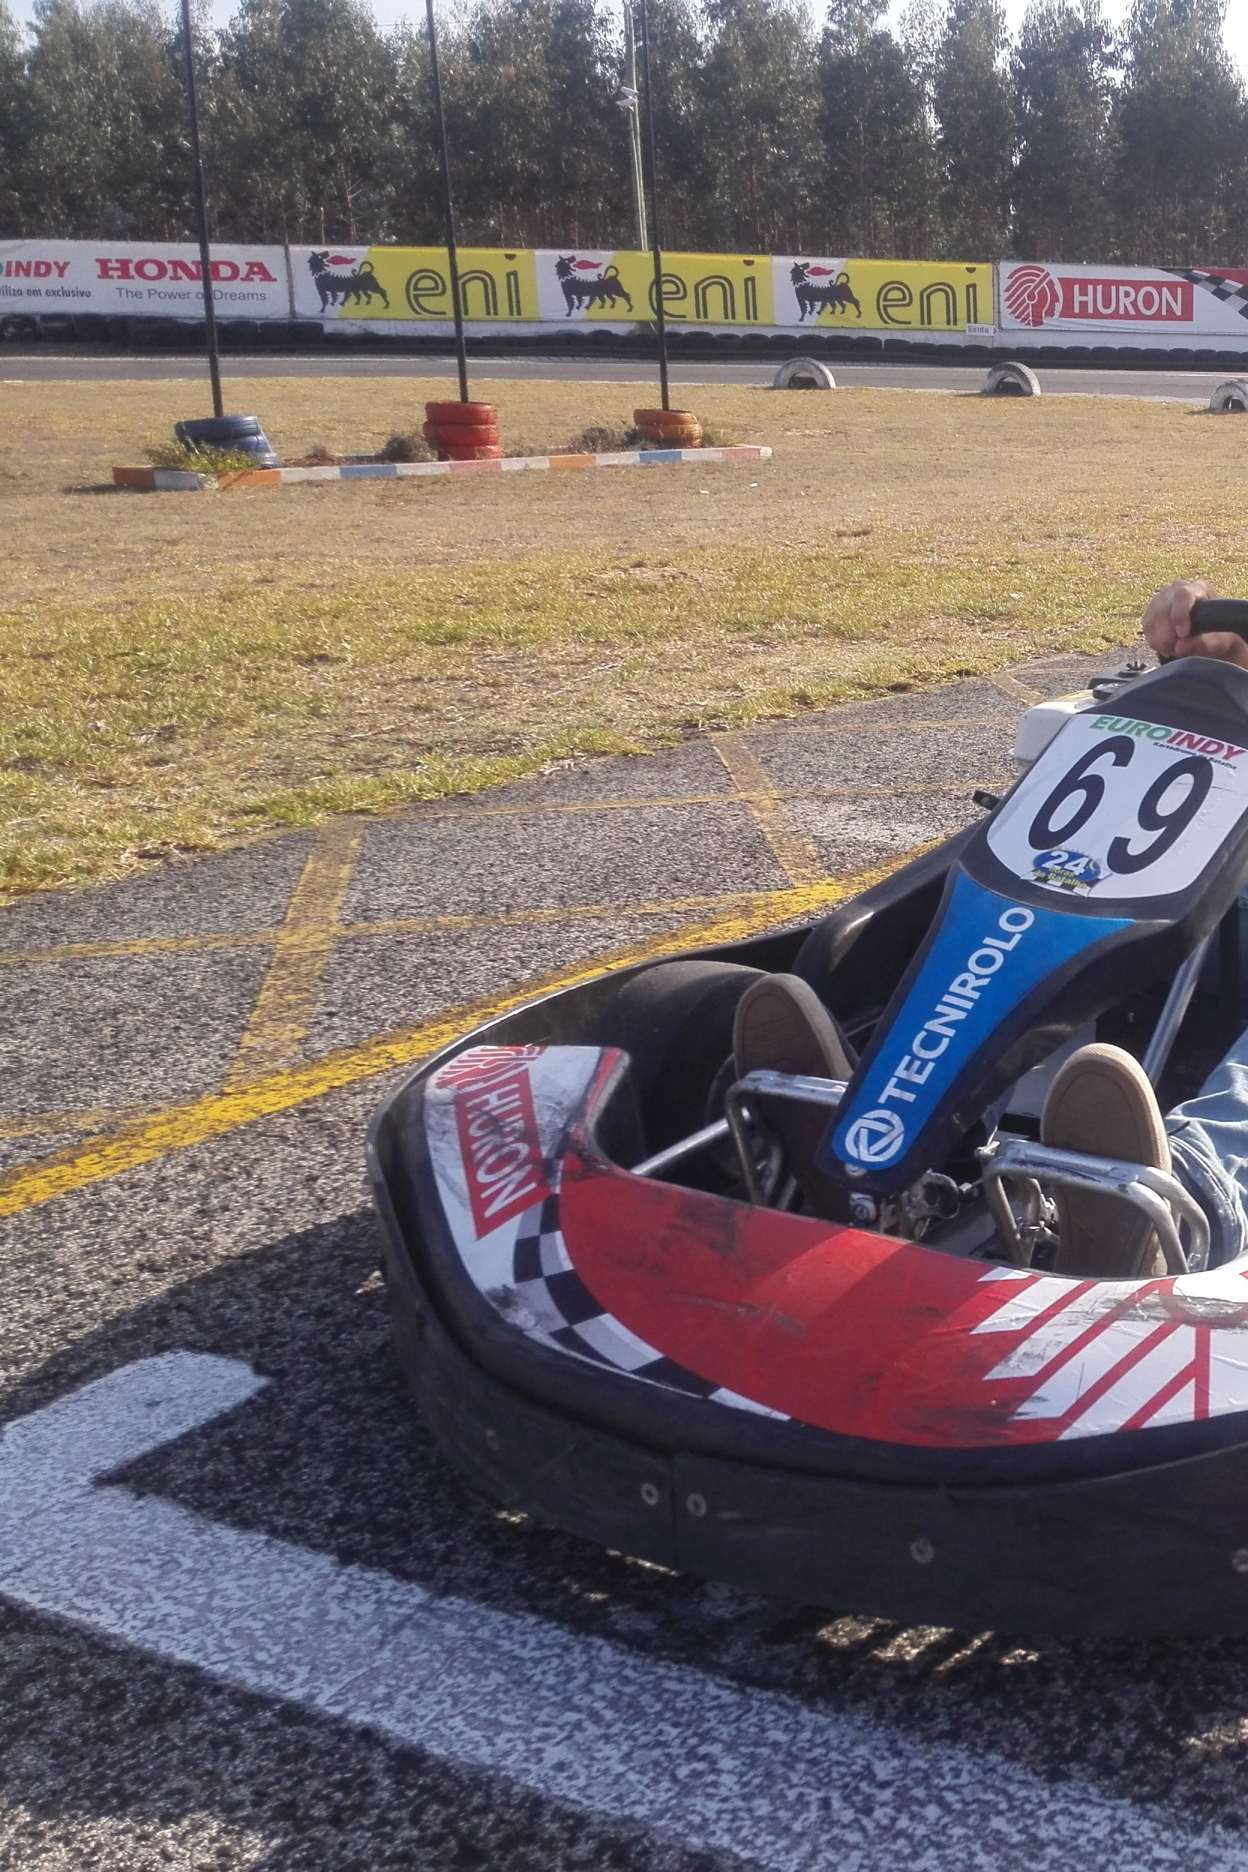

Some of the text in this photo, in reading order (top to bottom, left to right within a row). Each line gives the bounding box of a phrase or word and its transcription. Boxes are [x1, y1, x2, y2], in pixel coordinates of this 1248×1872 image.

[0, 260, 71, 278] INDY
[95, 257, 278, 283] HONDA
[116, 287, 144, 300] The
[147, 288, 192, 301] Power
[213, 289, 267, 301] Dreams
[405, 254, 522, 317] eni
[648, 259, 759, 321] eni
[876, 267, 979, 326] eni
[1072, 283, 1183, 316] HURON
[1089, 715, 1248, 761] EUROINDY
[1028, 735, 1214, 875] 69
[1041, 850, 1089, 876] 24
[877, 907, 1035, 1104] TECNIROLO
[465, 1083, 537, 1219] HURON
